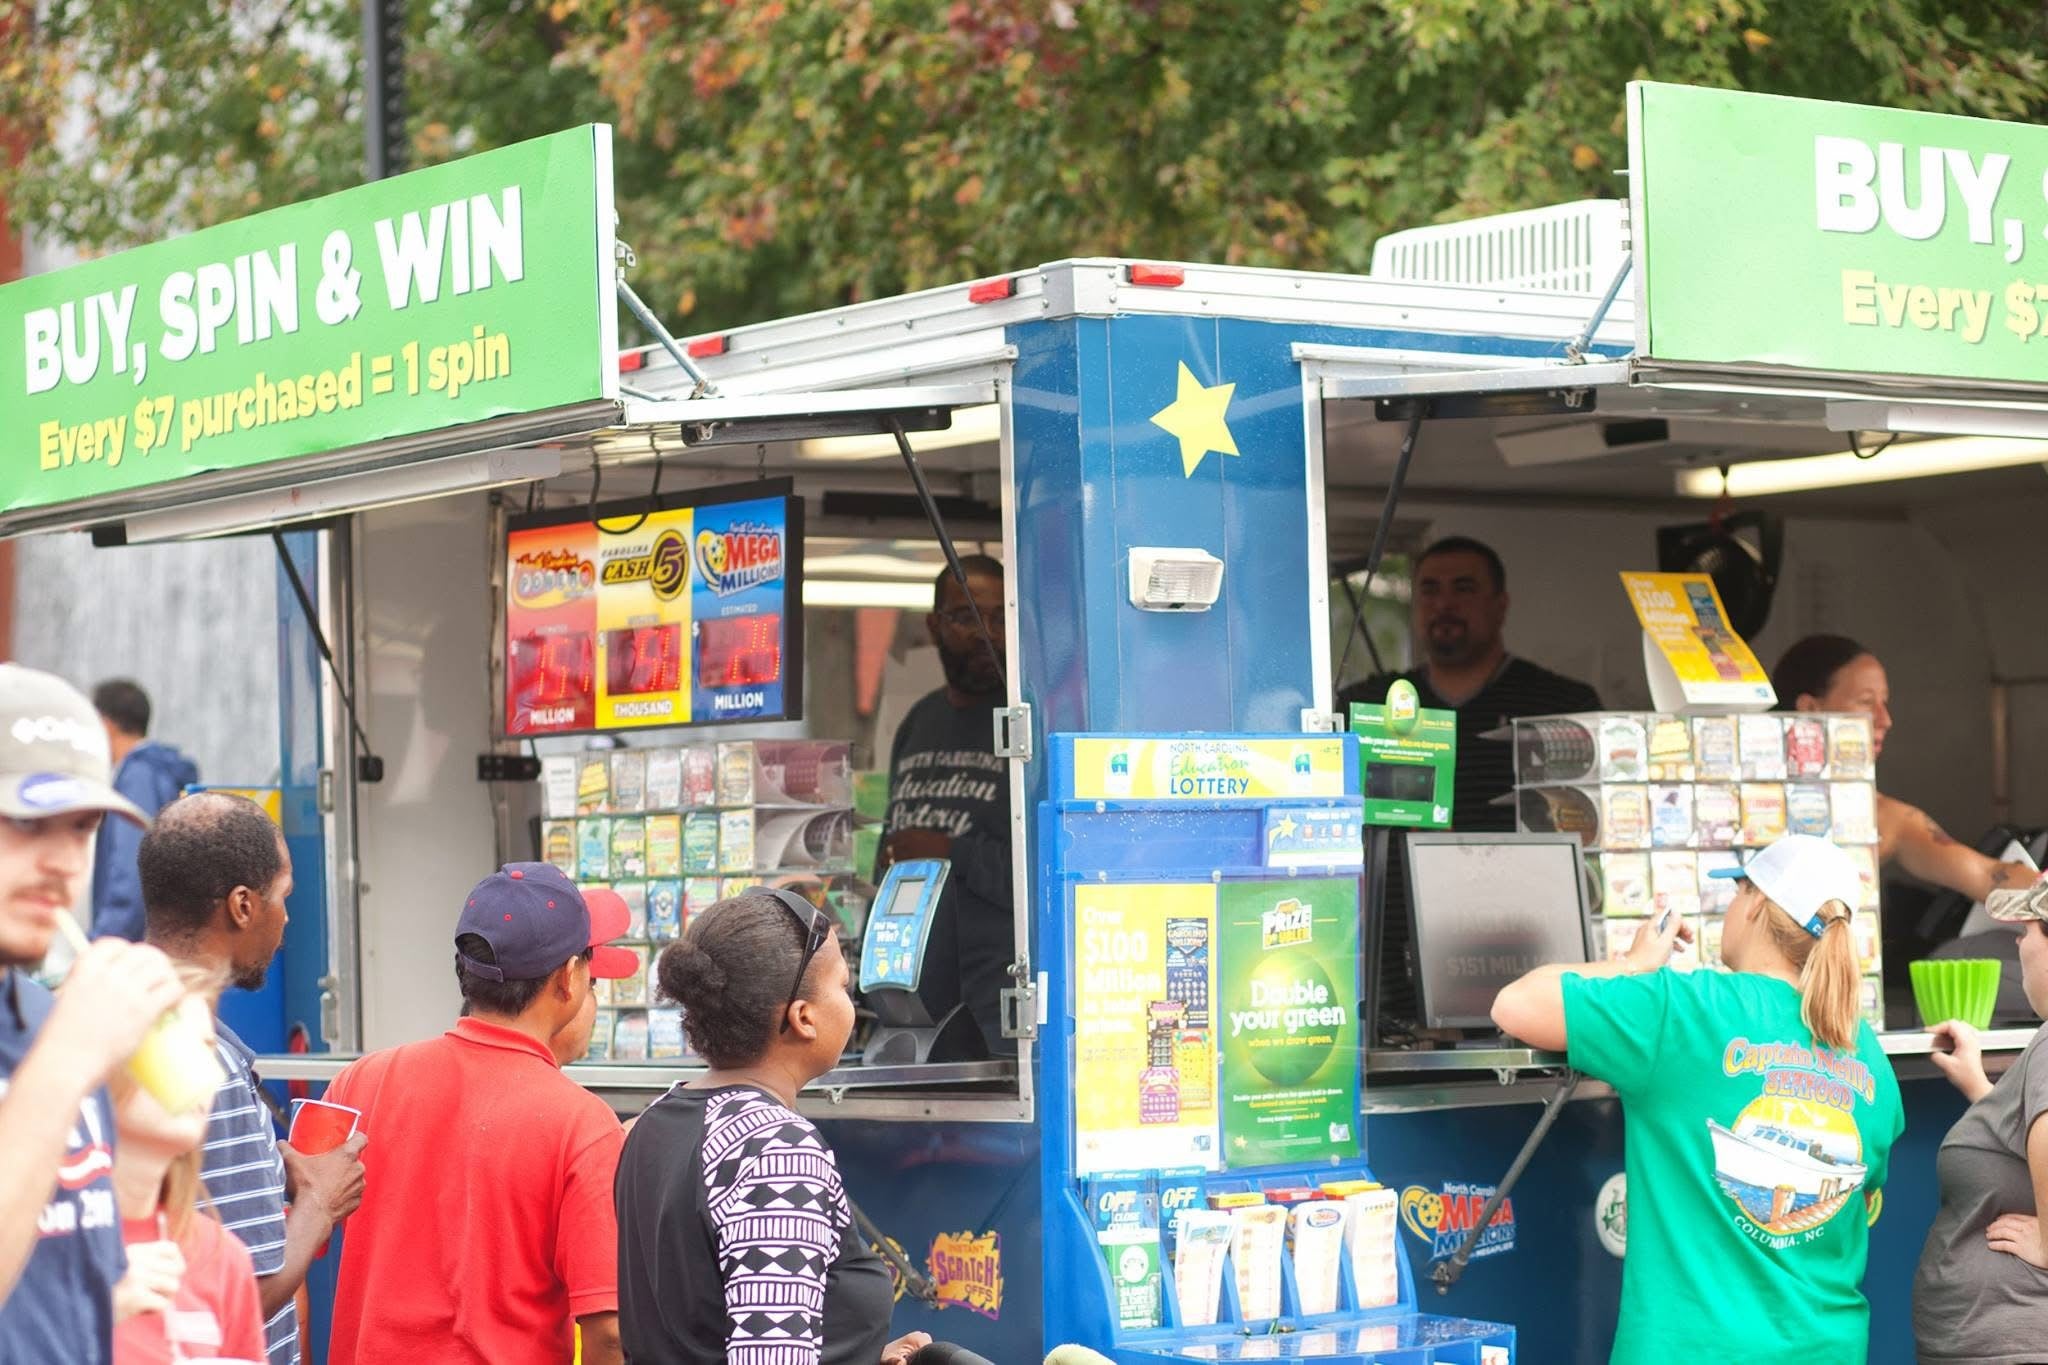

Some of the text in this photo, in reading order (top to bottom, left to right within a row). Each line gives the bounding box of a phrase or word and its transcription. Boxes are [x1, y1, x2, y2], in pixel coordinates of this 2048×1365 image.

[1815, 135, 2025, 264] BUY,
[24, 185, 524, 394] BUY, SPIN & WIN
[1842, 269, 1993, 344] Every
[40, 325, 510, 471] Every $7 purchased = 1 spin
[603, 561, 651, 580] CASH
[652, 542, 687, 589] 5
[723, 533, 779, 573] MEGA
[530, 708, 575, 725] MILLION
[614, 700, 673, 717] THOUSAND
[715, 692, 763, 709] MILLION
[1170, 777, 1249, 795] LOTTERY
[1084, 929, 1147, 965] $100
[1250, 979, 1328, 1008] Double
[1230, 1006, 1346, 1037] your green
[1723, 1037, 1812, 1077] Captain
[1764, 1070, 1855, 1112] SEAFOOD
[1444, 1182, 1469, 1195] North
[948, 1244, 984, 1254] INSTANT
[1805, 1226, 1825, 1242] NC
[936, 1250, 994, 1287] SCRATCH
[965, 1284, 993, 1302] OFFS
